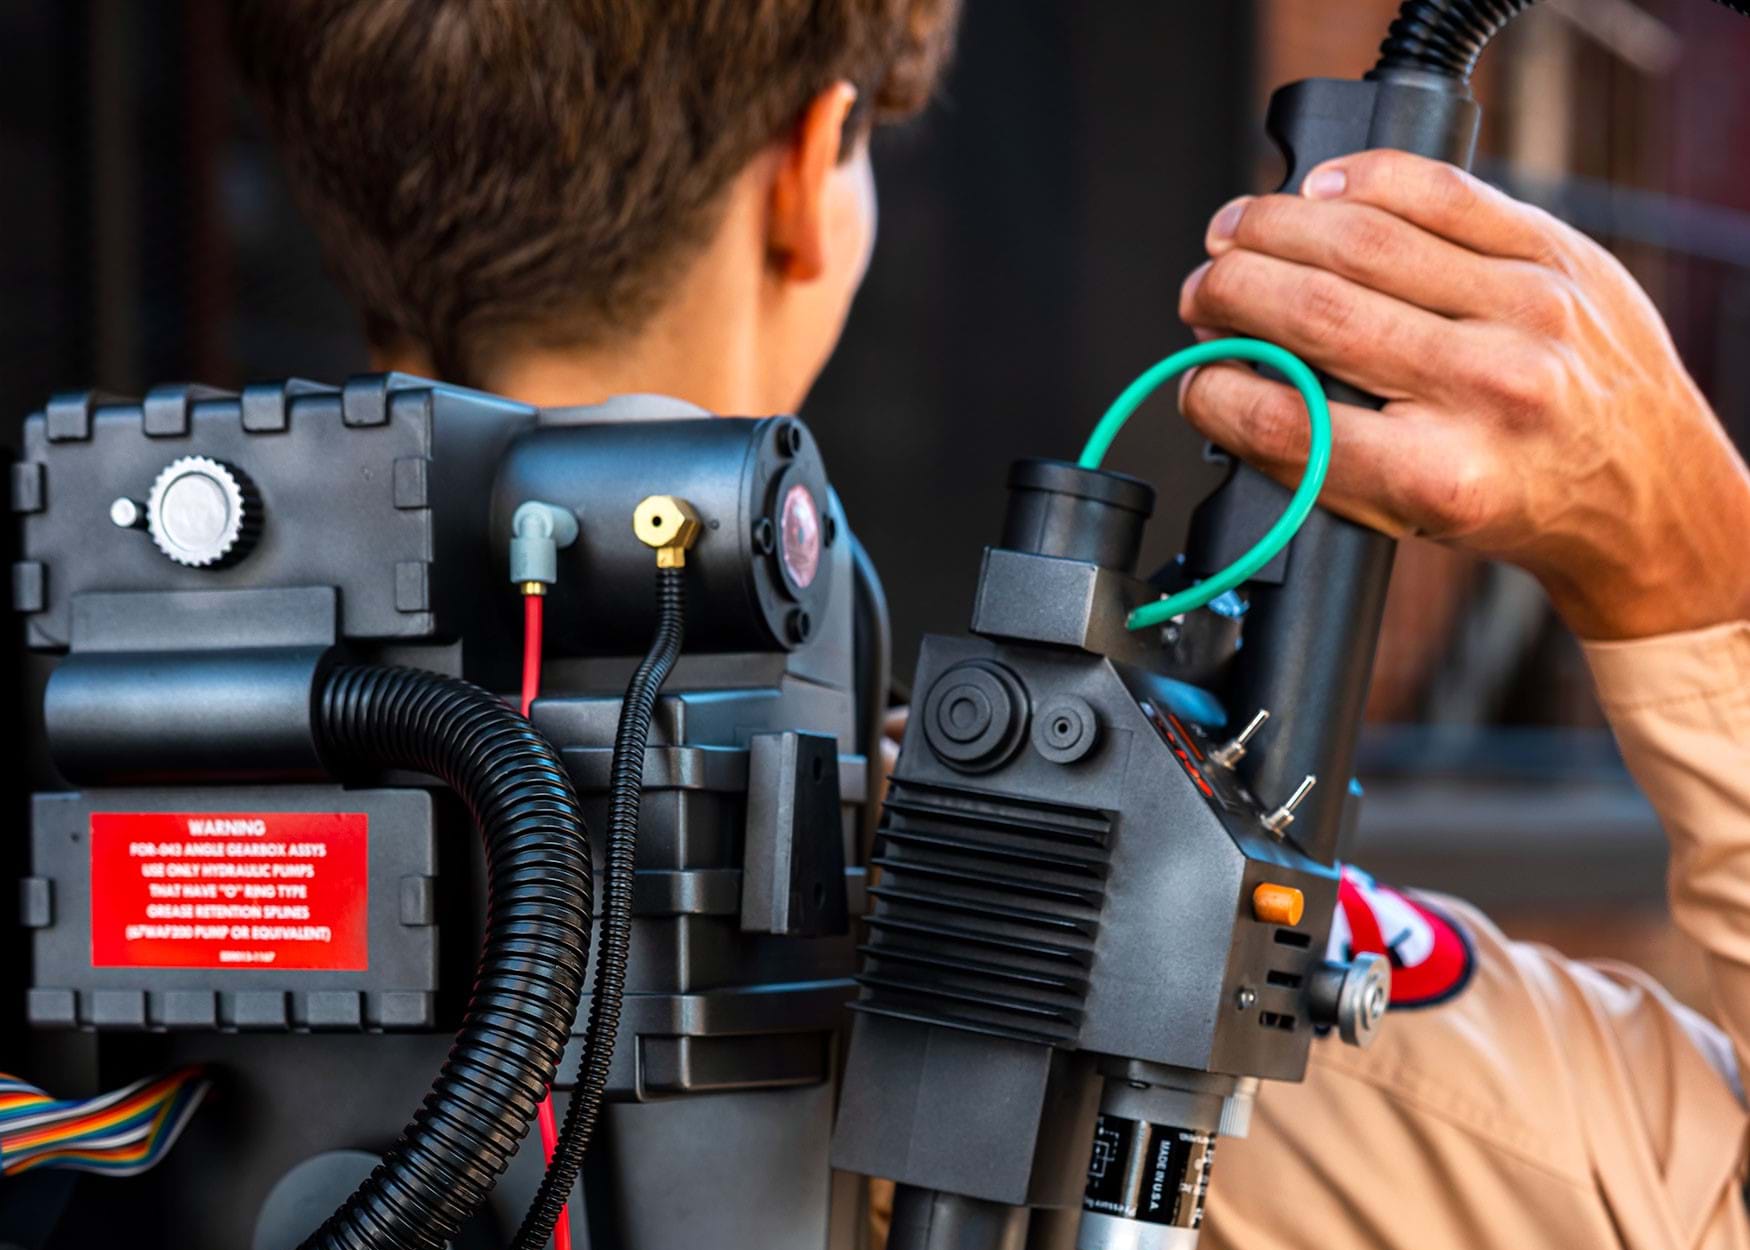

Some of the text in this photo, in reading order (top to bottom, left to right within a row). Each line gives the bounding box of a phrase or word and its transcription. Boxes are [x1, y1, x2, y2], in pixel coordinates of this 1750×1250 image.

[188, 819, 266, 836] WARNING
[184, 843, 224, 858] ANGLE
[226, 843, 286, 858] GEARBOX
[288, 843, 326, 858] ASSYS
[142, 863, 314, 878] USE ONLY HYDRAULIC PUMPS
[149, 884, 181, 899] THAT
[183, 884, 217, 899] HAVE
[244, 884, 276, 899] RING
[277, 884, 307, 899] TYPE
[146, 904, 310, 919] GREASE RETENTION SPLINES
[194, 925, 229, 940] PUMP
[230, 926, 250, 940] OR
[251, 926, 331, 942] EQUIVALENT)
[1157, 1139, 1171, 1170] MADE
